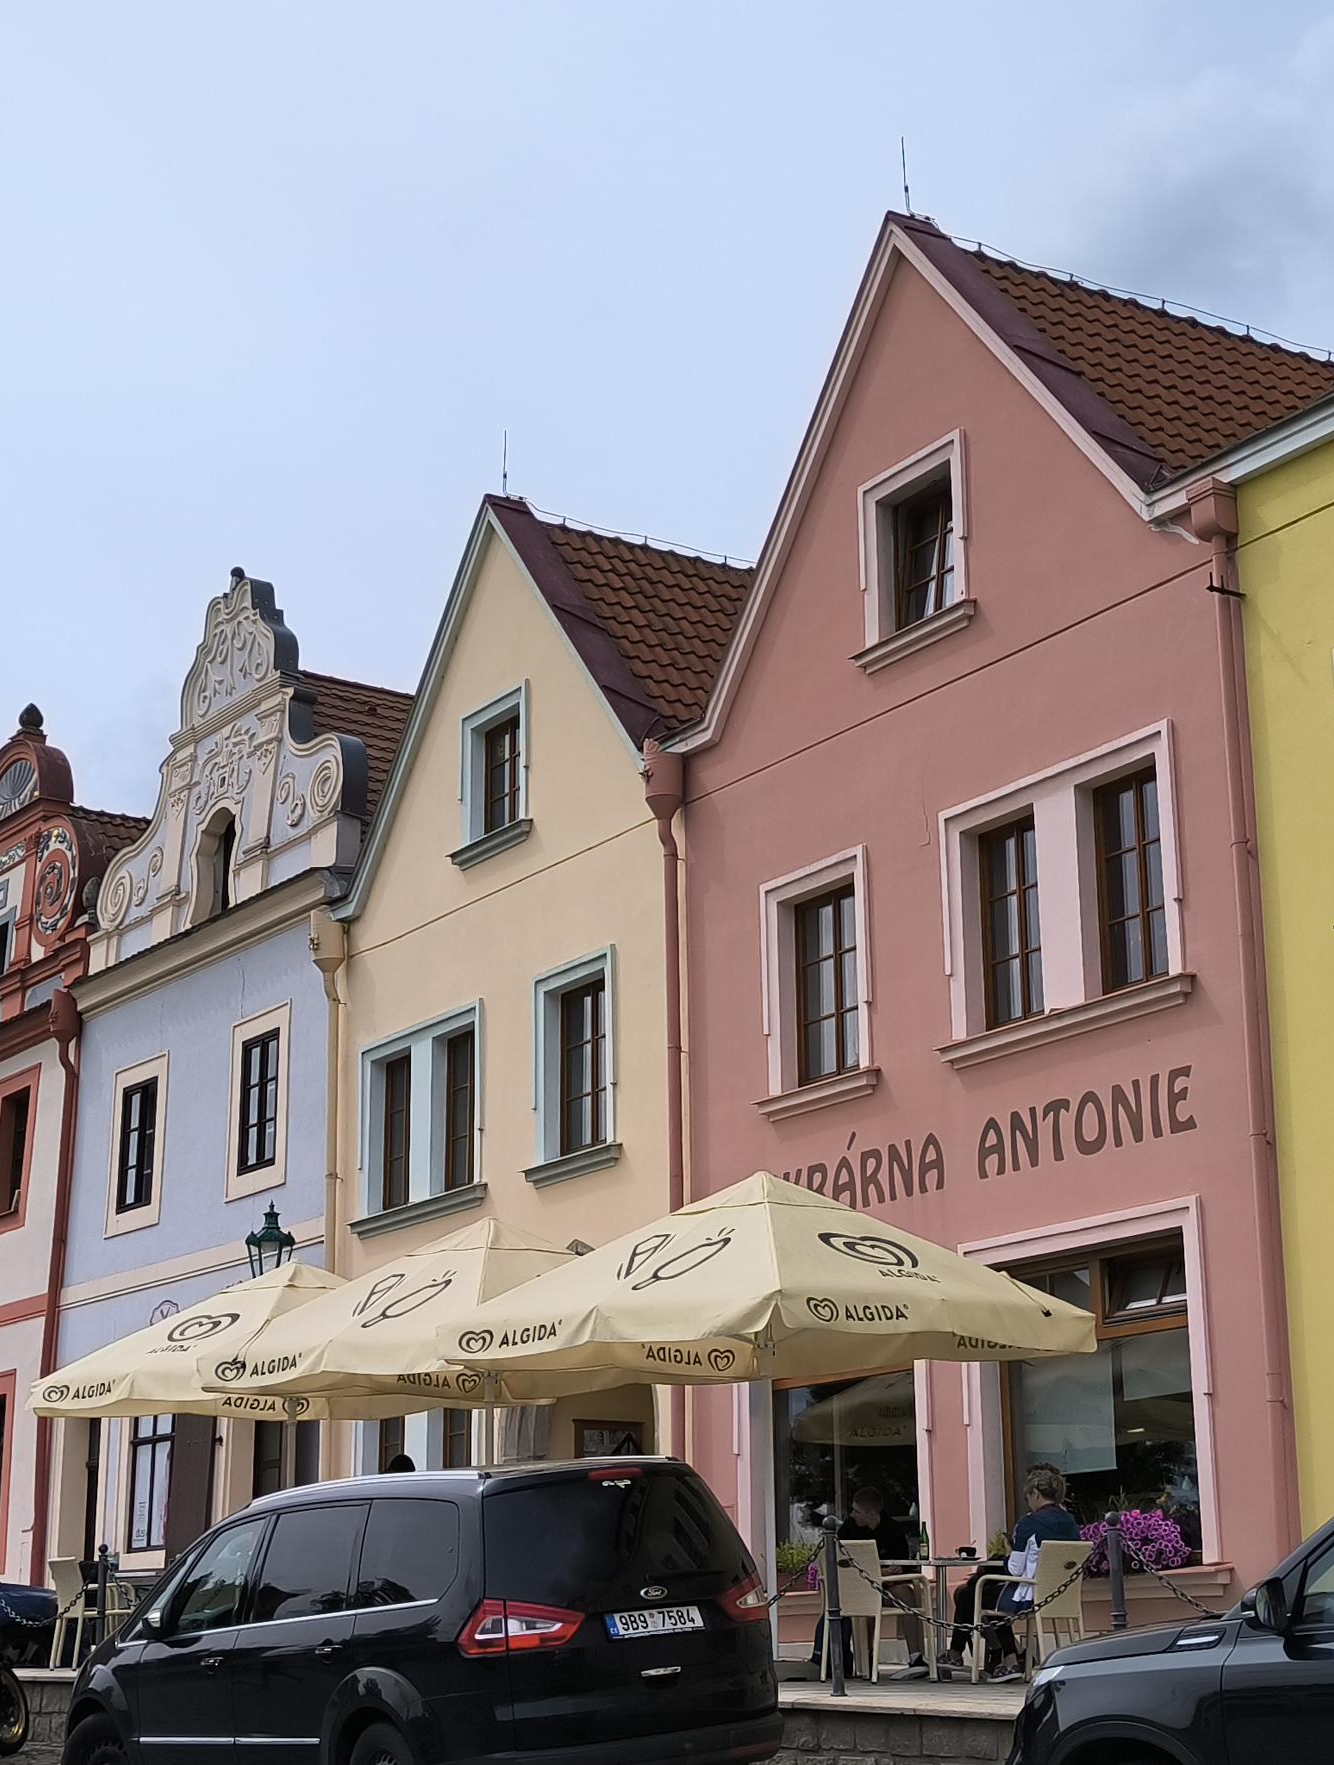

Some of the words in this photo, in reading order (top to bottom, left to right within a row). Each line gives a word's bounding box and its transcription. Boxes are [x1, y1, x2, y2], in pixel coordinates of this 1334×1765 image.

[774, 1131, 945, 1211] RÁRNA
[976, 1064, 1198, 1180] ANTONIE
[845, 1304, 909, 1322] ALGIDA
[498, 1321, 558, 1348] ALGIDA
[249, 1356, 300, 1378] ALGIDA
[71, 1381, 113, 1400] ALGIDA
[619, 1612, 649, 1632] 9B9
[657, 1607, 696, 1628] 7584
